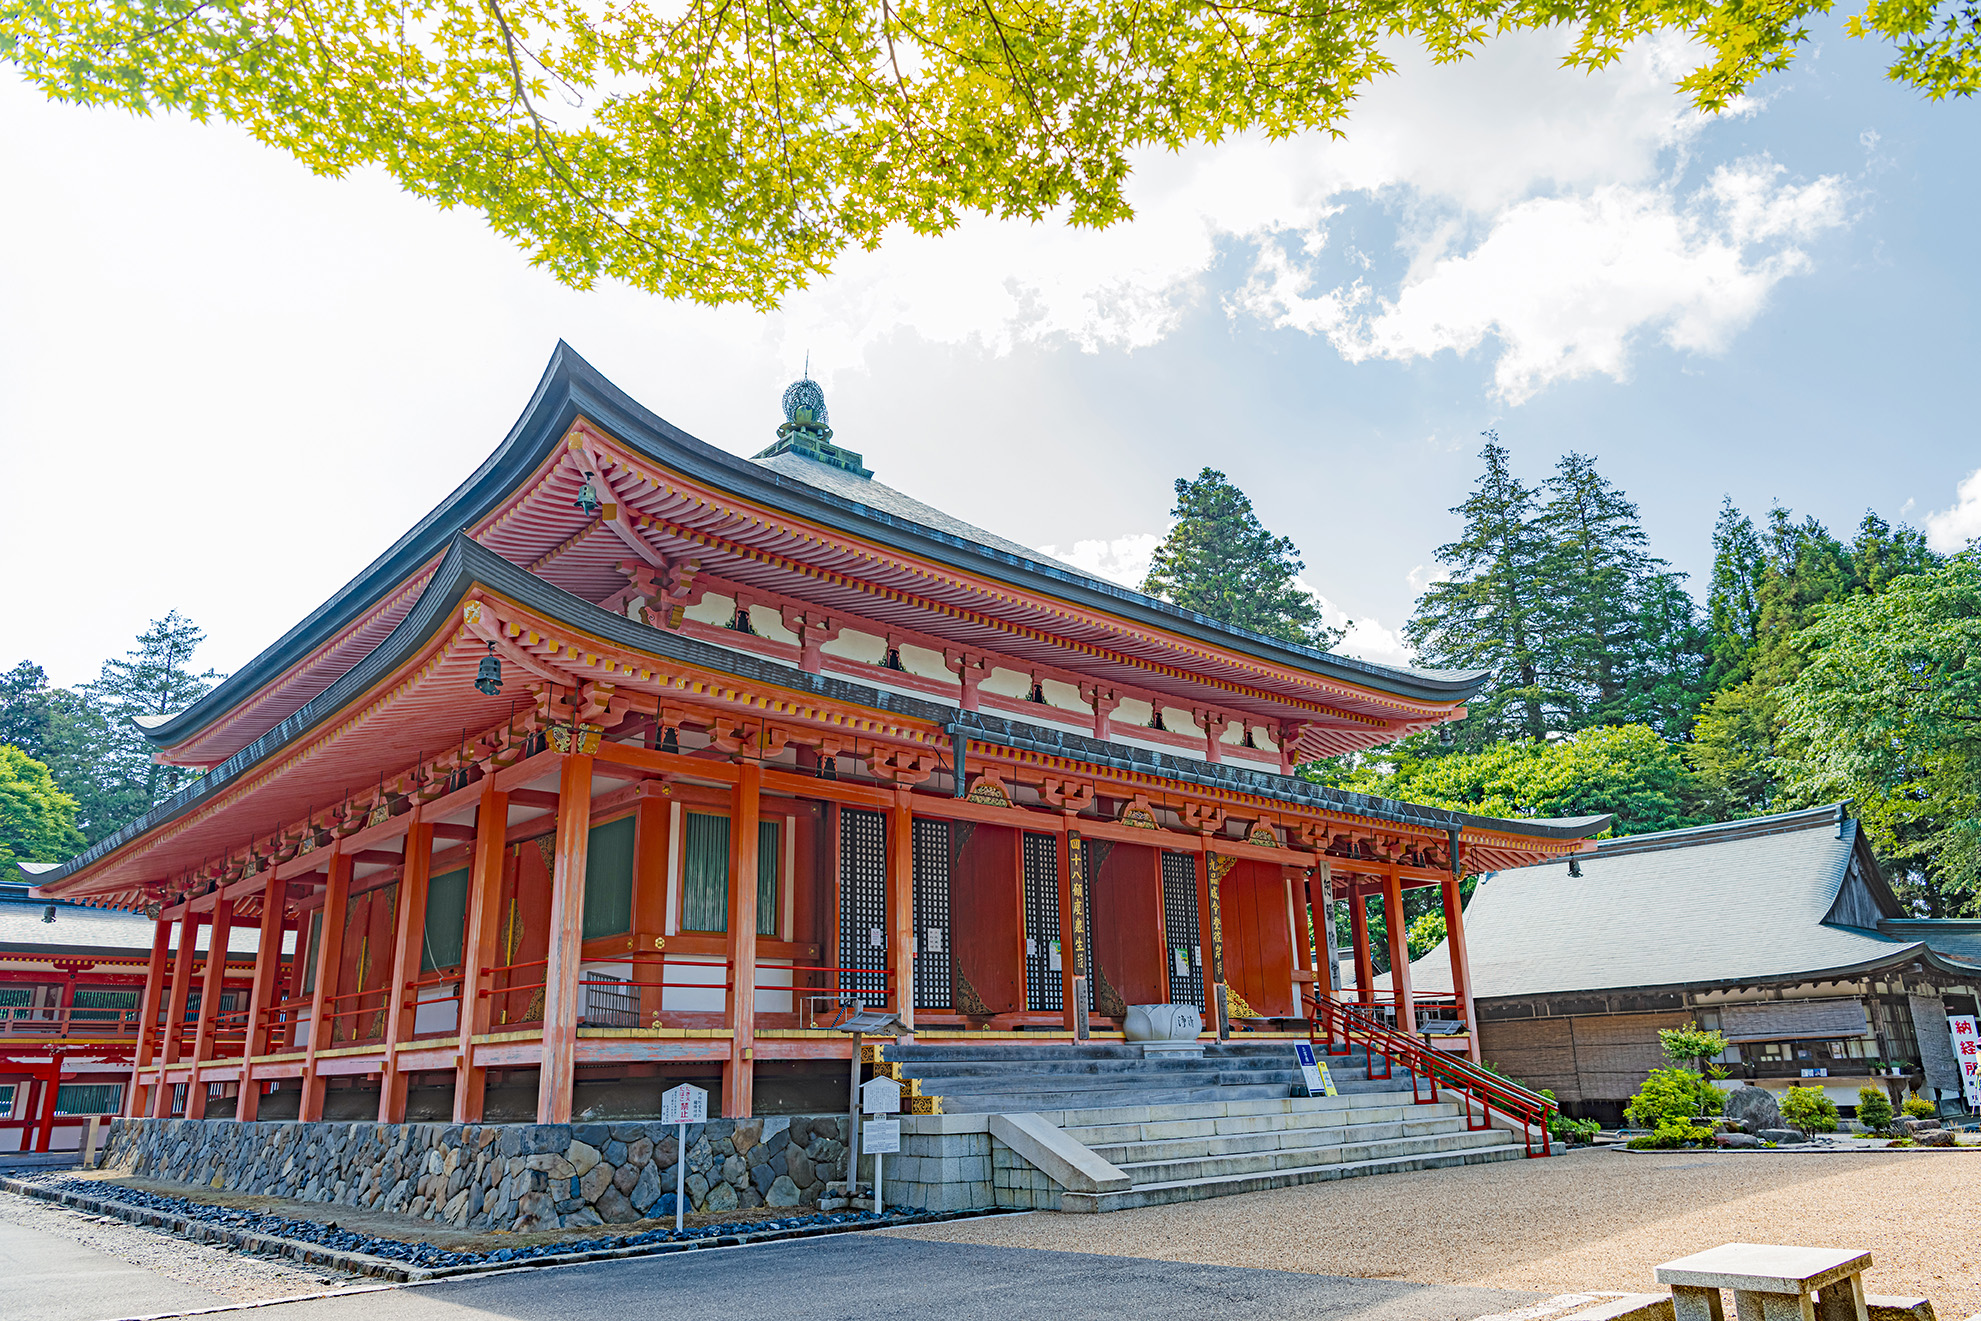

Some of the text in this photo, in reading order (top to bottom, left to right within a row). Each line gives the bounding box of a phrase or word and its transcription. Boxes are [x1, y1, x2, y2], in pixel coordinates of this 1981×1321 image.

[1954, 1019, 1978, 1076] 納経所
[681, 1102, 689, 1118] 禁止
